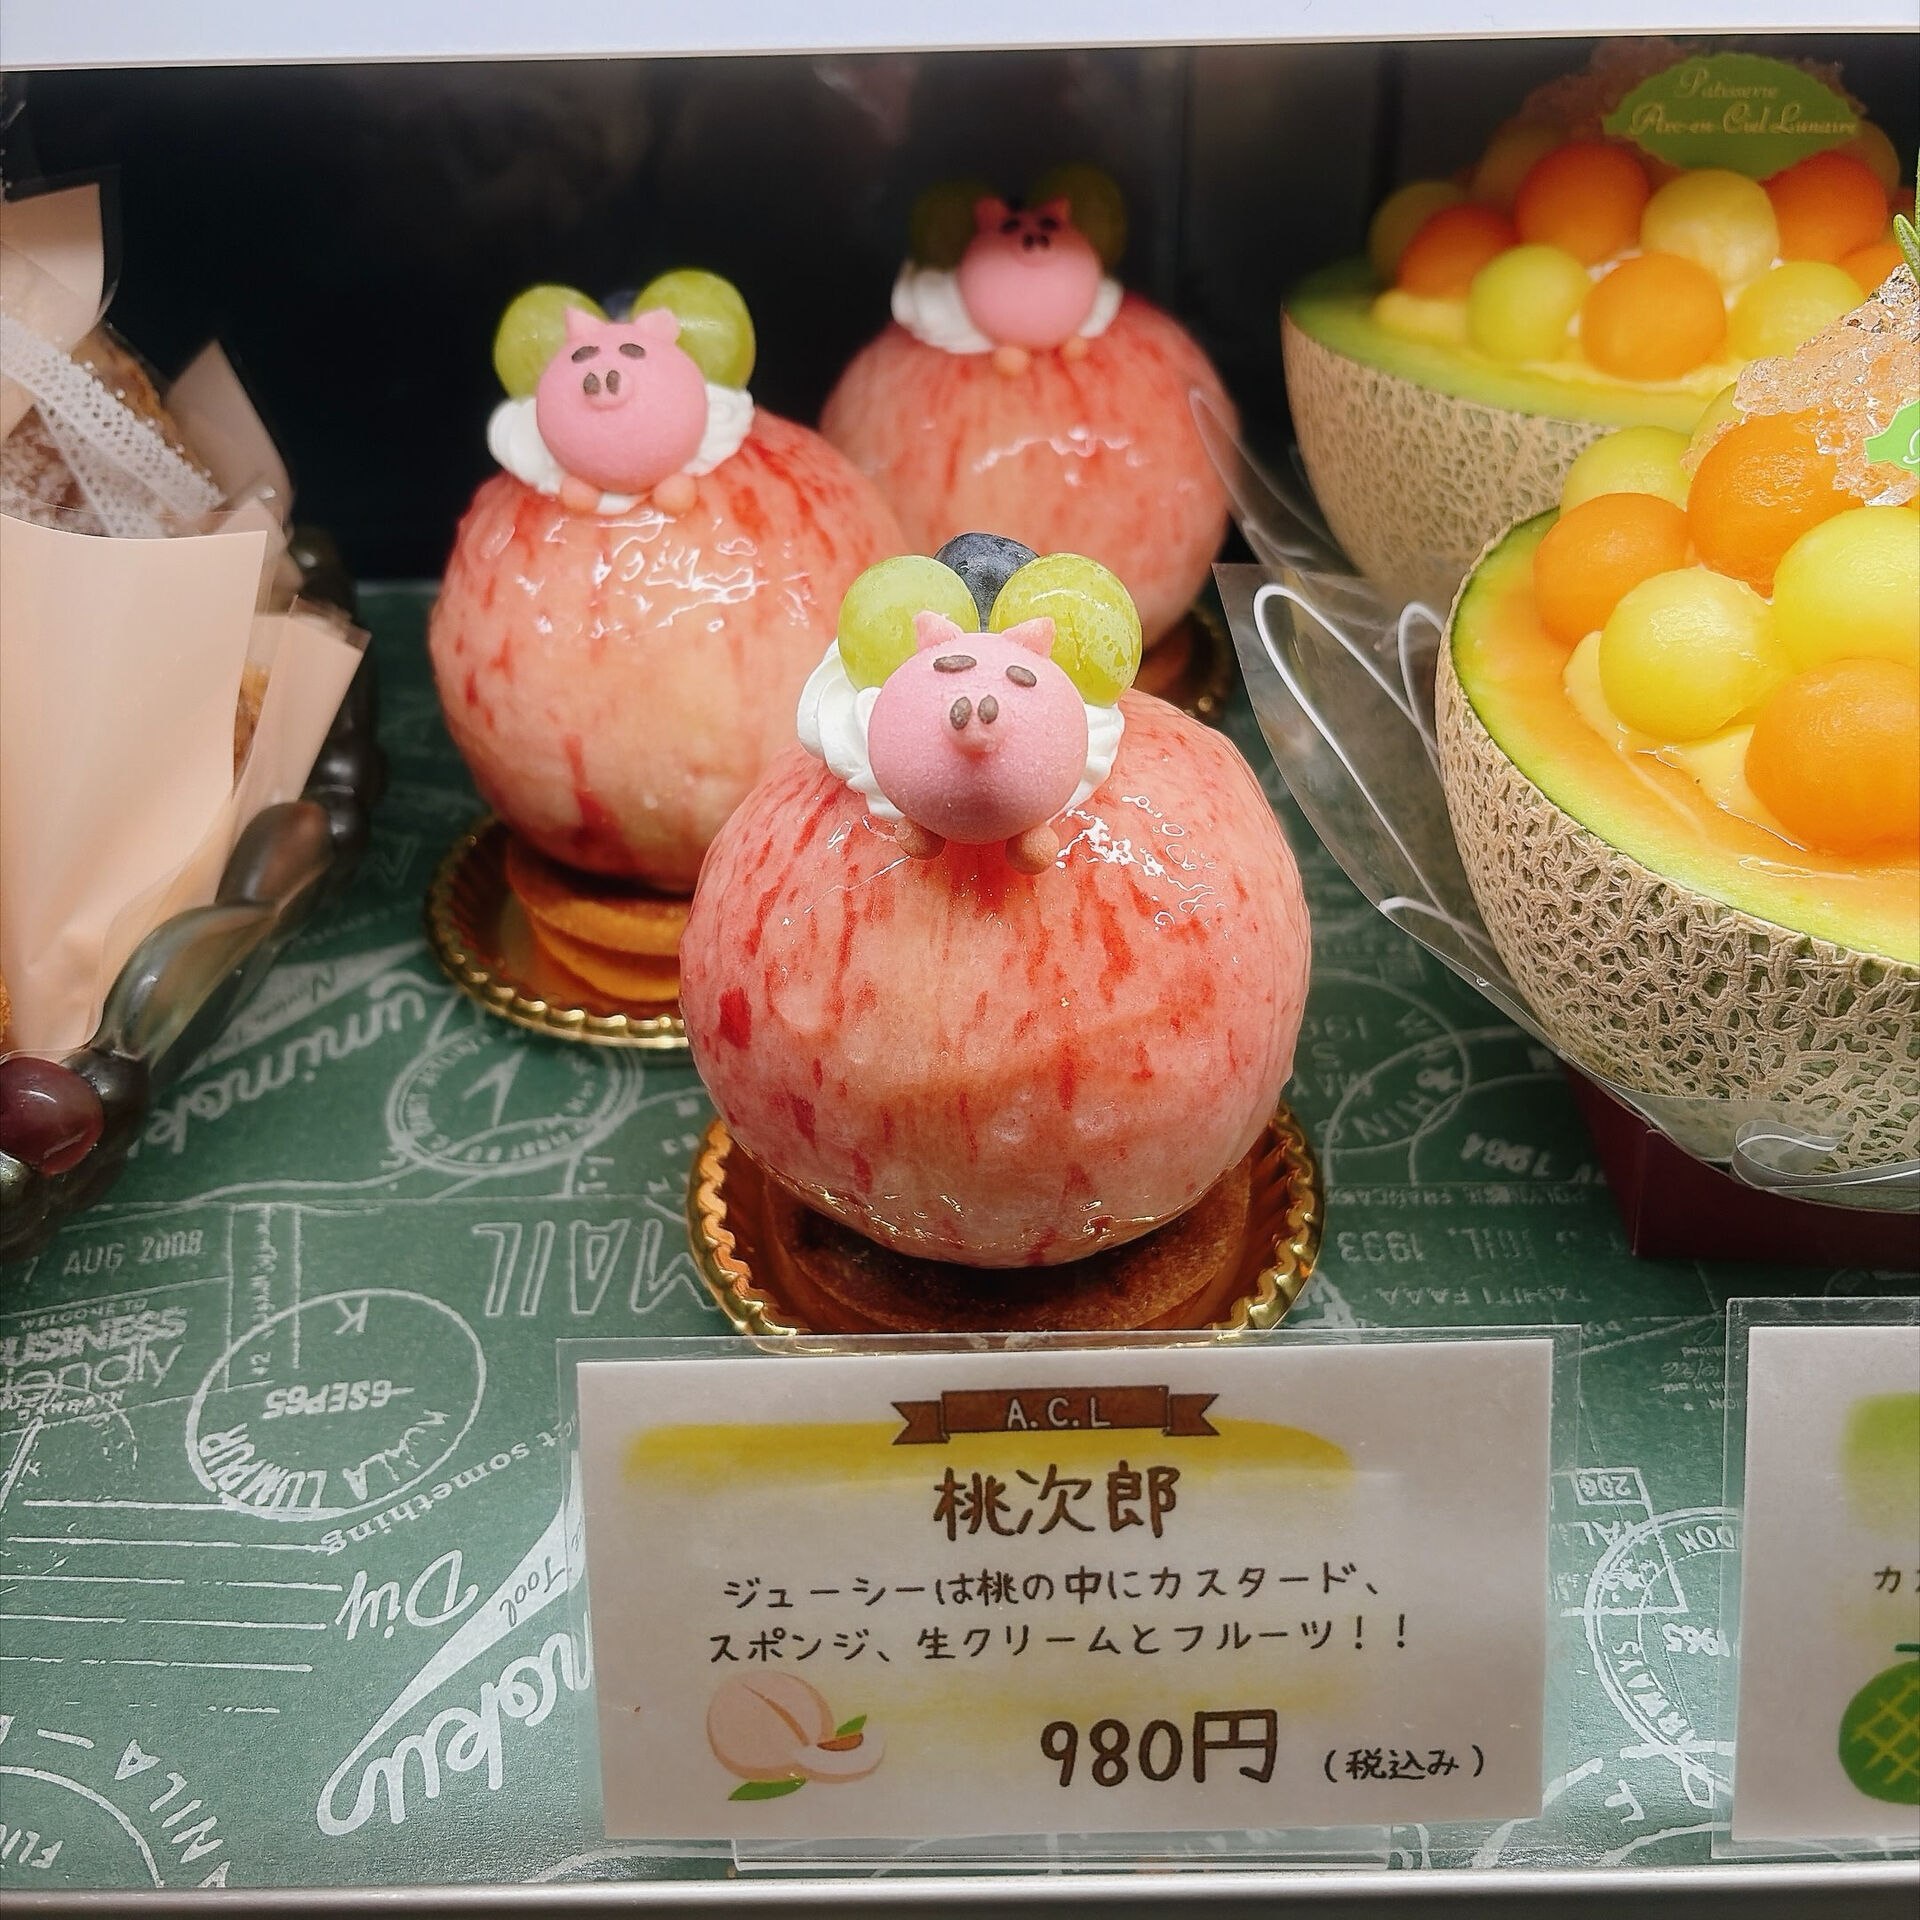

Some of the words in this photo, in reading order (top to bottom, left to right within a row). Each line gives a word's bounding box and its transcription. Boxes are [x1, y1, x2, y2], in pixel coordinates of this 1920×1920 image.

[63, 1243, 125, 1277] AUG
[1007, 1396, 1111, 1430] A.C.L
[321, 1440, 531, 1555] something
[933, 1459, 1181, 1542] 桃次郎
[1874, 1565, 1920, 1594] カ
[1040, 1708, 1278, 1788] 980円
